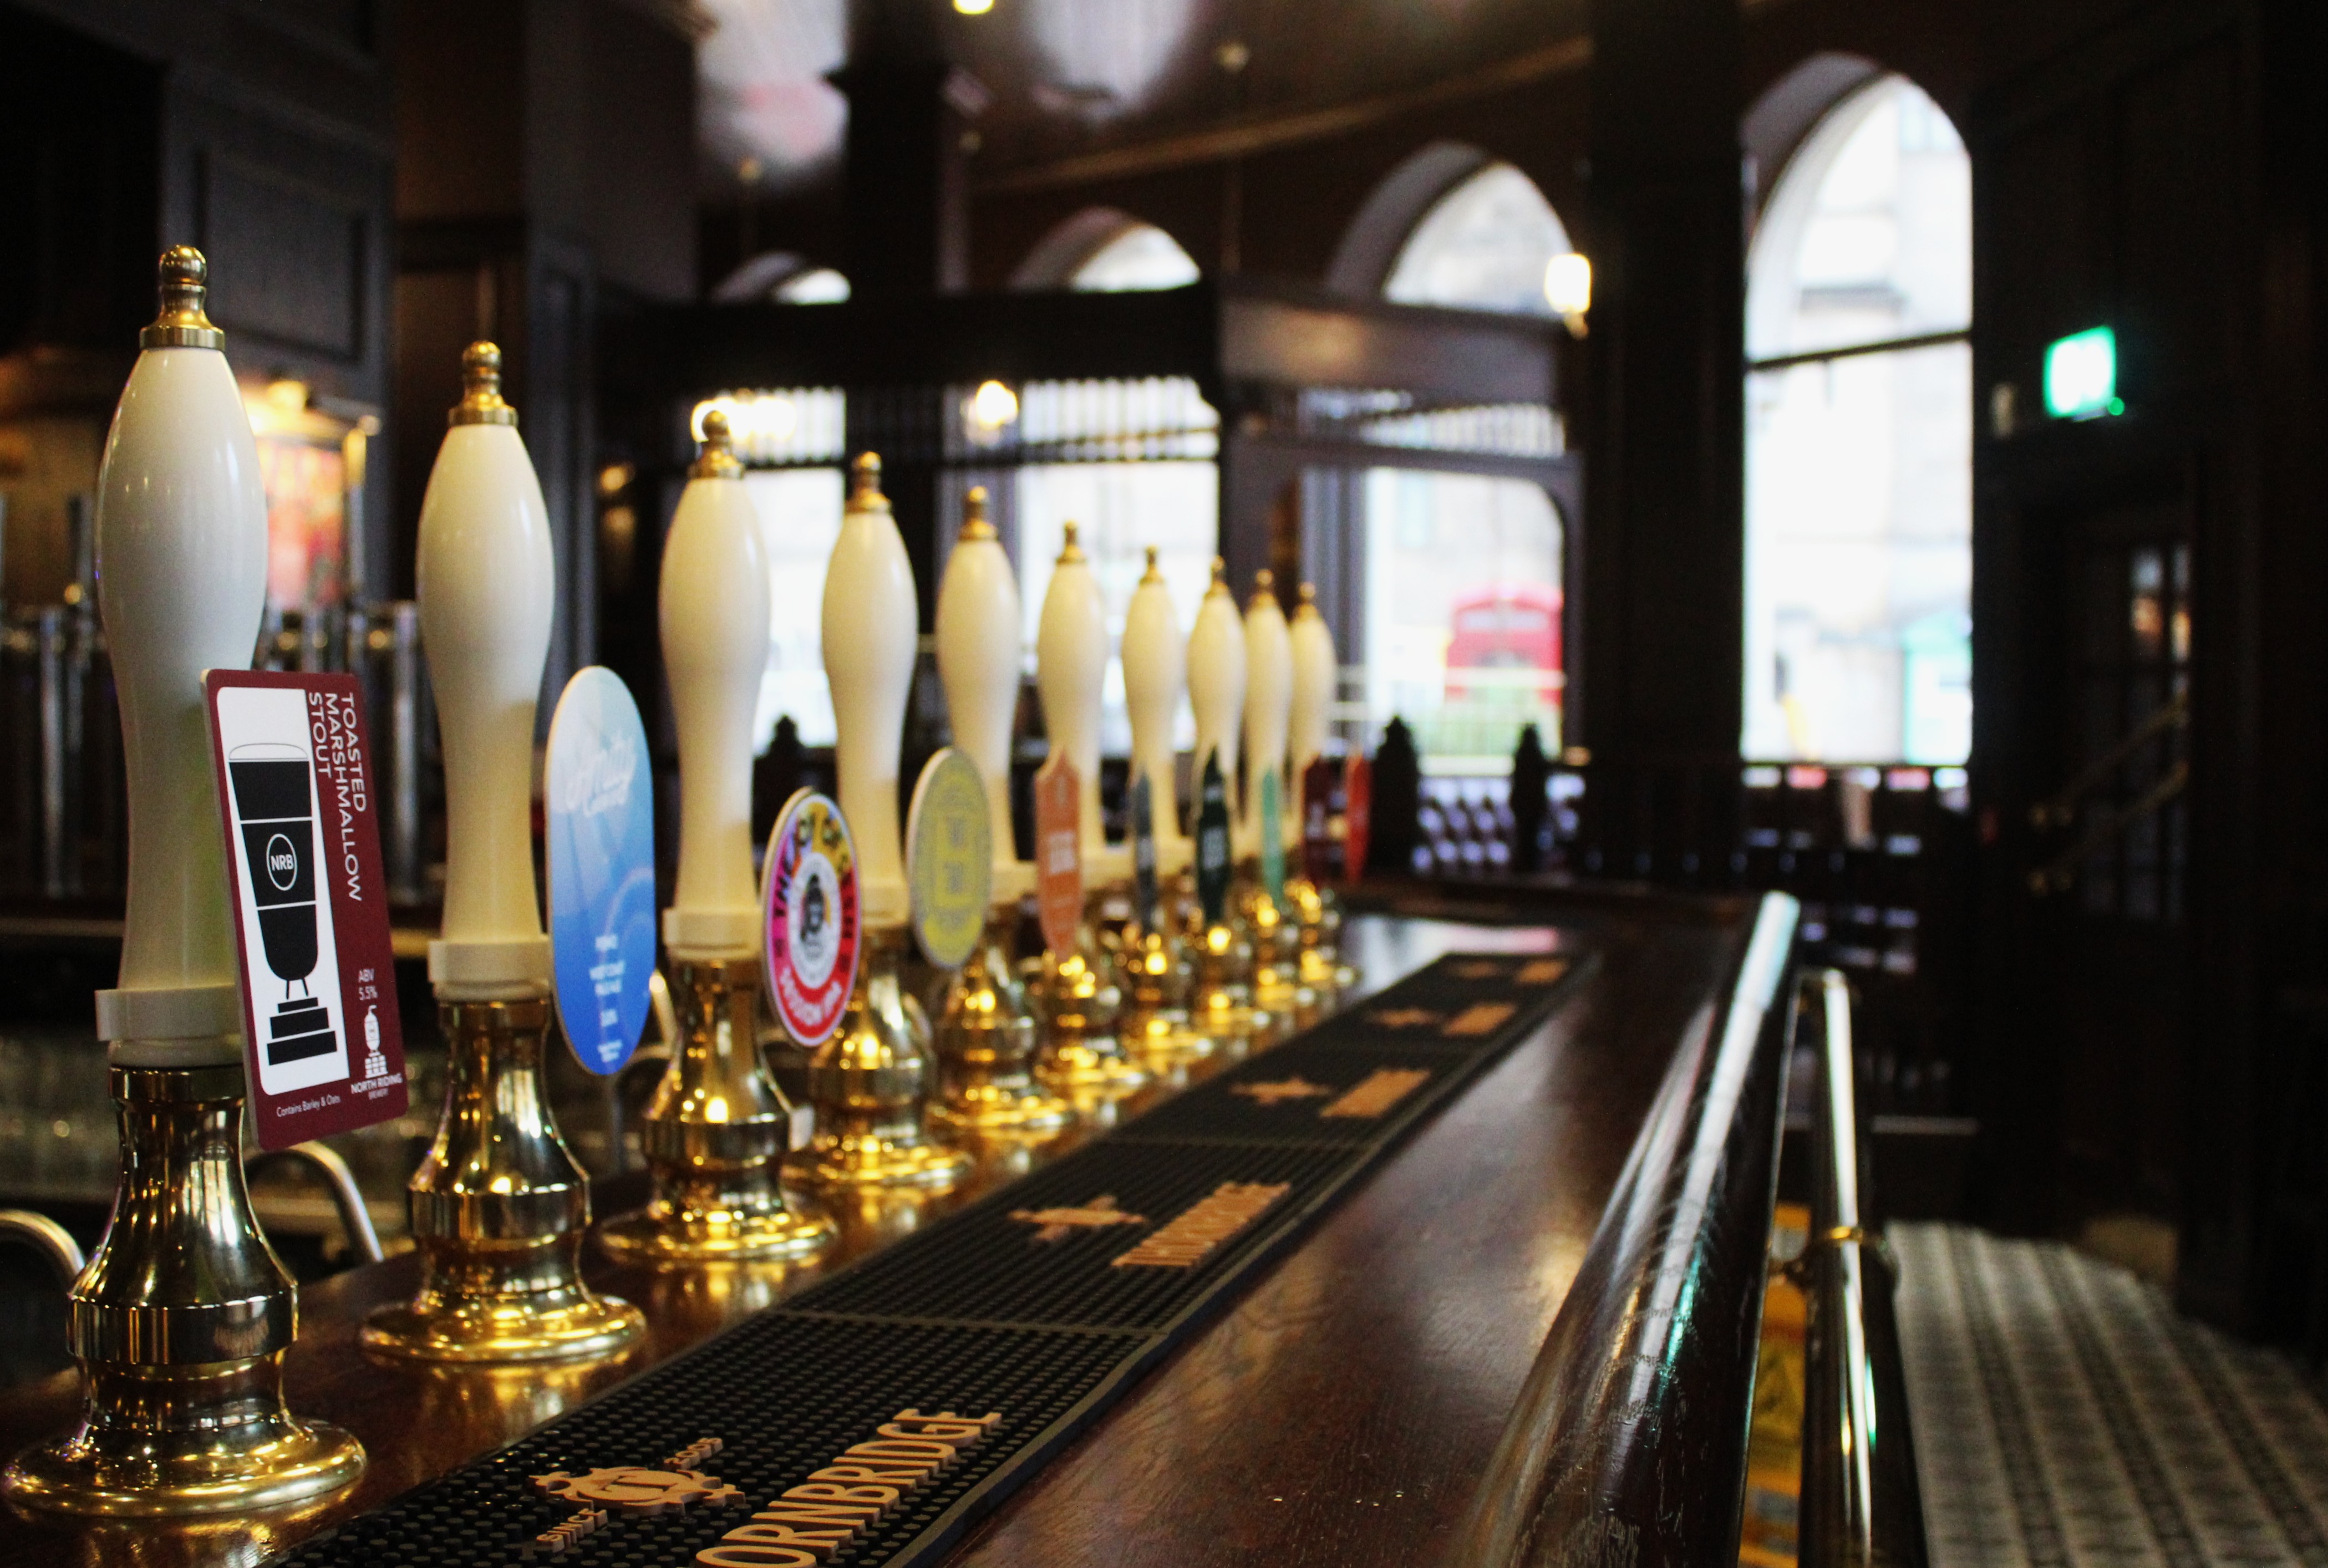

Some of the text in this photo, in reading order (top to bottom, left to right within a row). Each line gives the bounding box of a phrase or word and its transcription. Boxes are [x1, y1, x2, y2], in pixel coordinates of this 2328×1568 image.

[309, 692, 332, 778] STOUT
[341, 692, 367, 812] TOASTED
[325, 693, 362, 902] MARSHMALLOW
[270, 854, 294, 871] NRB
[358, 968, 375, 983] ABV
[358, 985, 378, 1001] 5.5%
[350, 1079, 378, 1094] NORTH
[377, 1072, 403, 1089] RIDING
[276, 1103, 302, 1117] Contains
[536, 1508, 608, 1549] SINCE
